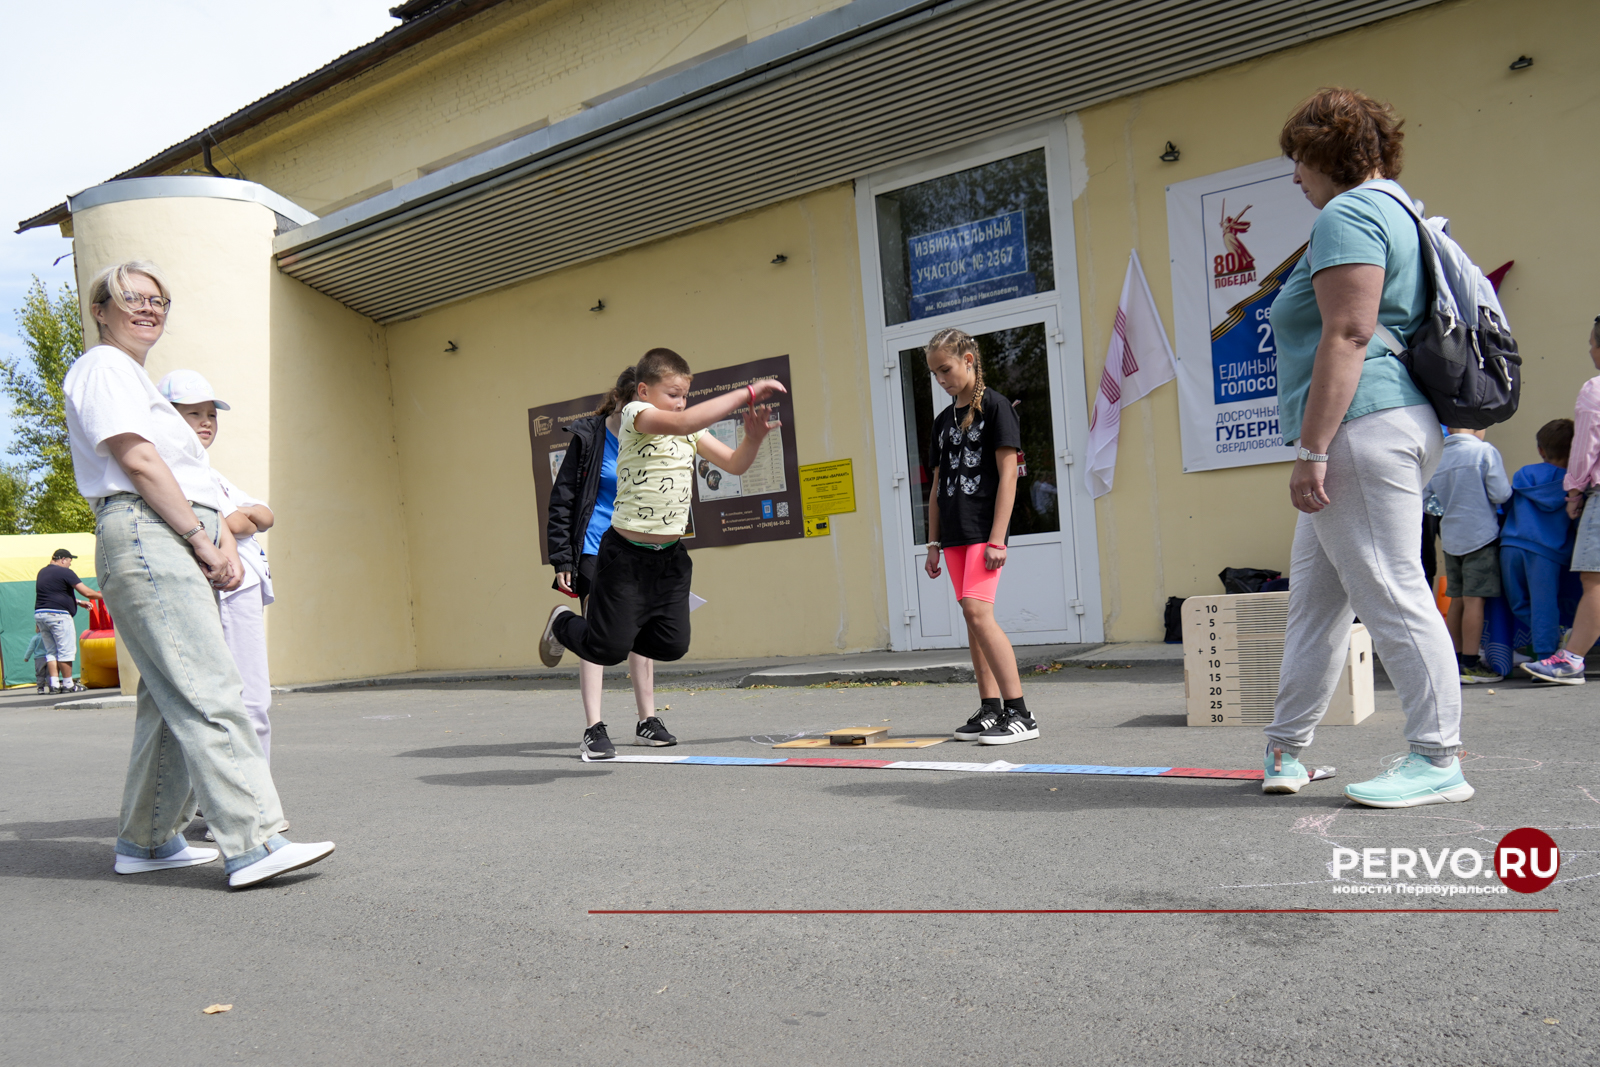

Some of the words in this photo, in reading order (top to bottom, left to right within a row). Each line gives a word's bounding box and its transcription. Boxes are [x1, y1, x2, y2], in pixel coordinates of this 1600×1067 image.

[915, 216, 1011, 257] ИЗБИРАТЕЛЬНЫЙ
[917, 258, 966, 283] УЧАСТОК
[972, 254, 984, 271] №
[987, 246, 1013, 267] 2367
[1213, 252, 1238, 275] 80
[1214, 271, 1257, 289] ПОБЕДА!
[937, 298, 961, 309] Юшкова
[962, 295, 977, 303] Льва
[978, 285, 1019, 300] Николаевича
[1219, 353, 1278, 381] ЕДИНЫЙ
[1216, 419, 1282, 442] ГУБЕРН
[1216, 436, 1284, 454] СВЕРДЛОВСКО
[1205, 605, 1218, 613] 10
[1209, 619, 1215, 627] 5
[1209, 632, 1216, 641] 0
[1210, 646, 1216, 654] 5
[1208, 660, 1220, 668] 10
[1209, 673, 1221, 681] 15
[1209, 687, 1222, 695] 20
[1210, 701, 1222, 709] 25
[1211, 714, 1223, 723] 30
